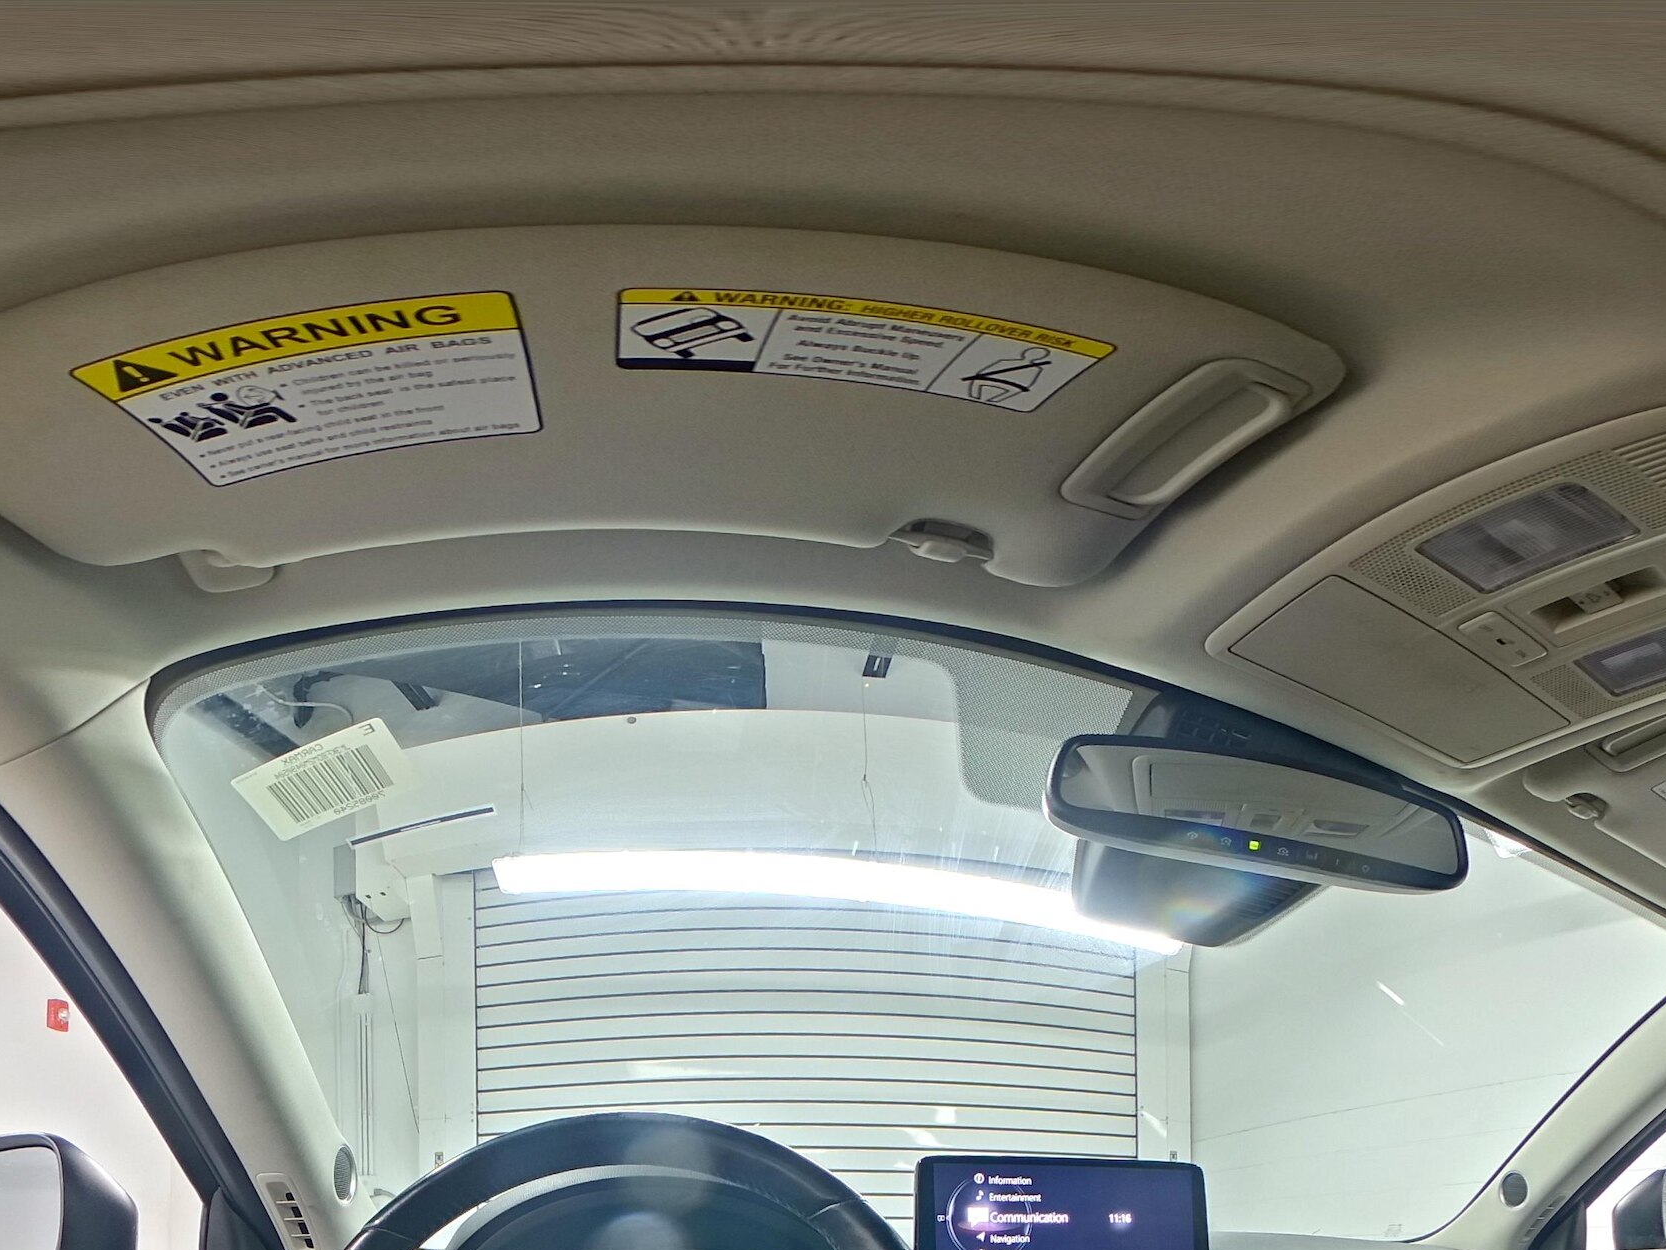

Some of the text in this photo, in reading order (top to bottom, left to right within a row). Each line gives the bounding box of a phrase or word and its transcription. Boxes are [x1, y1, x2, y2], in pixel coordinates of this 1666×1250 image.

[861, 304, 935, 321] HIGHER
[939, 315, 1034, 338] ROLLOVER
[1035, 332, 1076, 348] RISK
[167, 305, 462, 367] WARNING
[159, 337, 492, 401] EVEN WITH ADVANCED AIR BAGS
[988, 1175, 1032, 1186] Information
[989, 1192, 1041, 1203] Entertainment
[989, 1211, 1069, 1224] Communication
[1108, 1213, 1132, 1224] 11:16
[990, 1234, 1030, 1245] Navigation
